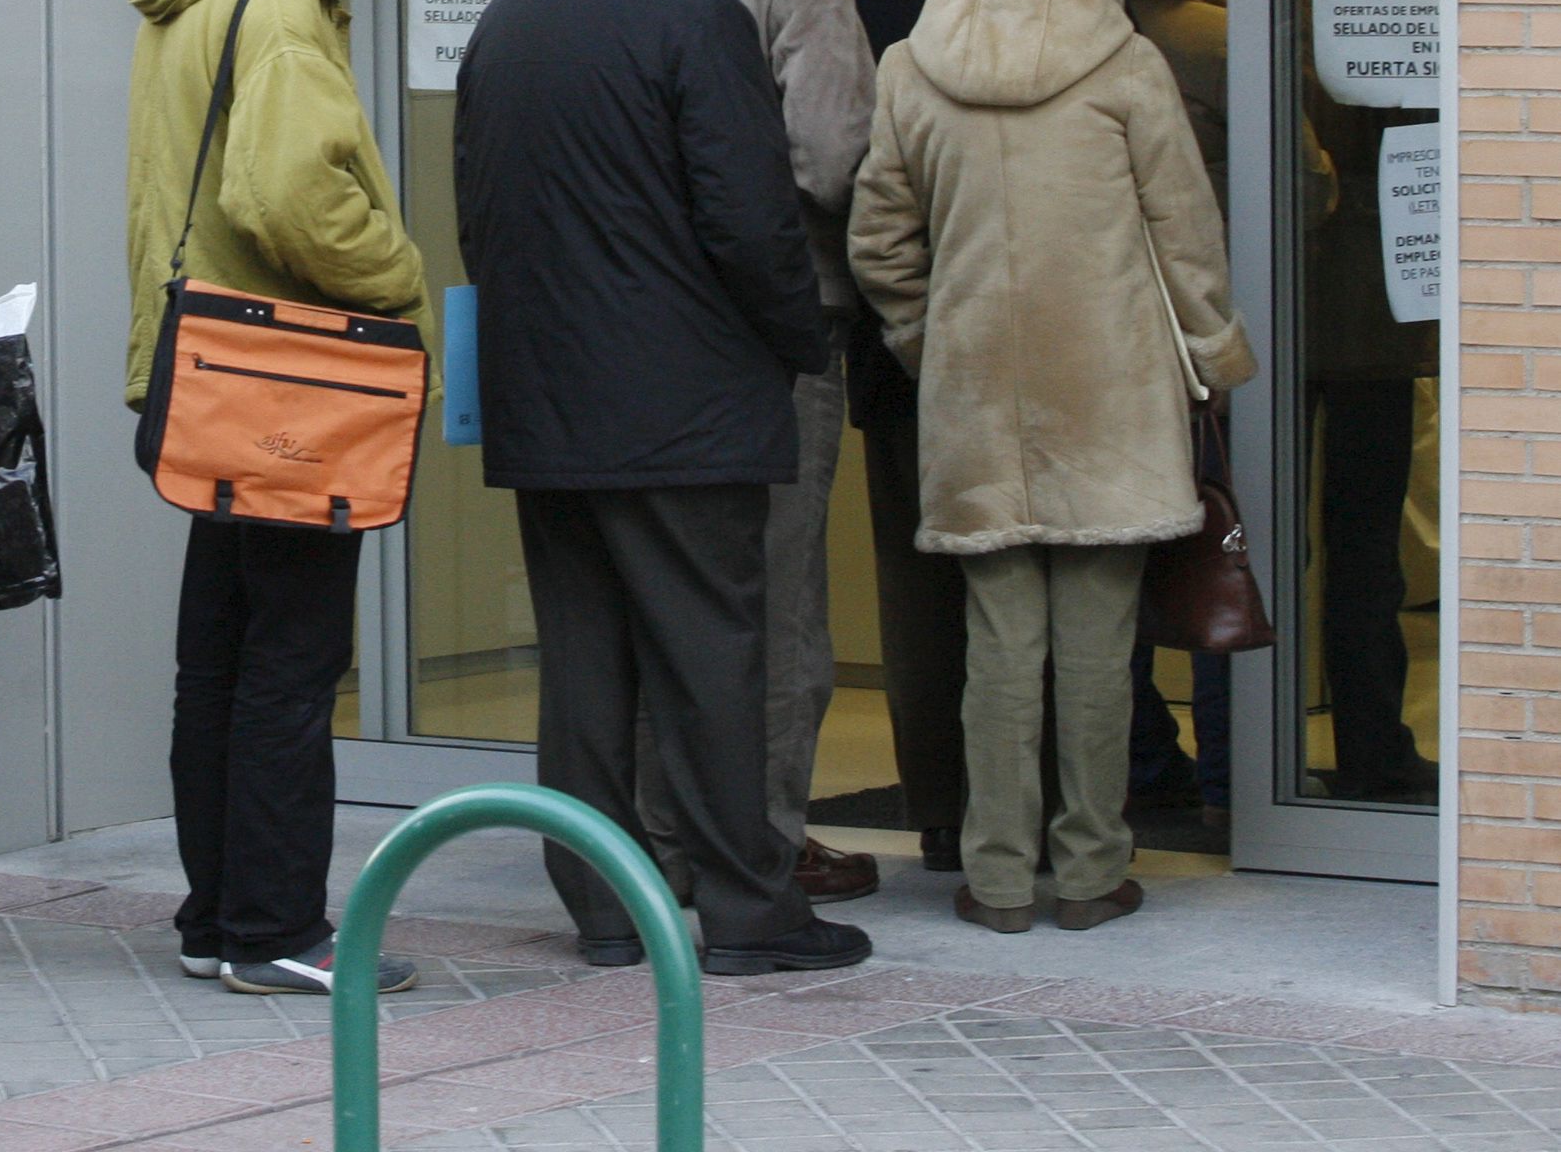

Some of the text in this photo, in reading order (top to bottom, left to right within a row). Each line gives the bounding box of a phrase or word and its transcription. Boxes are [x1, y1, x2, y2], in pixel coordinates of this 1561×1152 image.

[1333, 5, 1388, 16] OFERTAS
[1391, 6, 1407, 16] DE
[1333, 22, 1402, 36] SELLADO
[1406, 22, 1426, 35] DE
[1412, 41, 1432, 54] EN
[1346, 60, 1418, 76] PUERTA
[1401, 268, 1417, 281] DE
